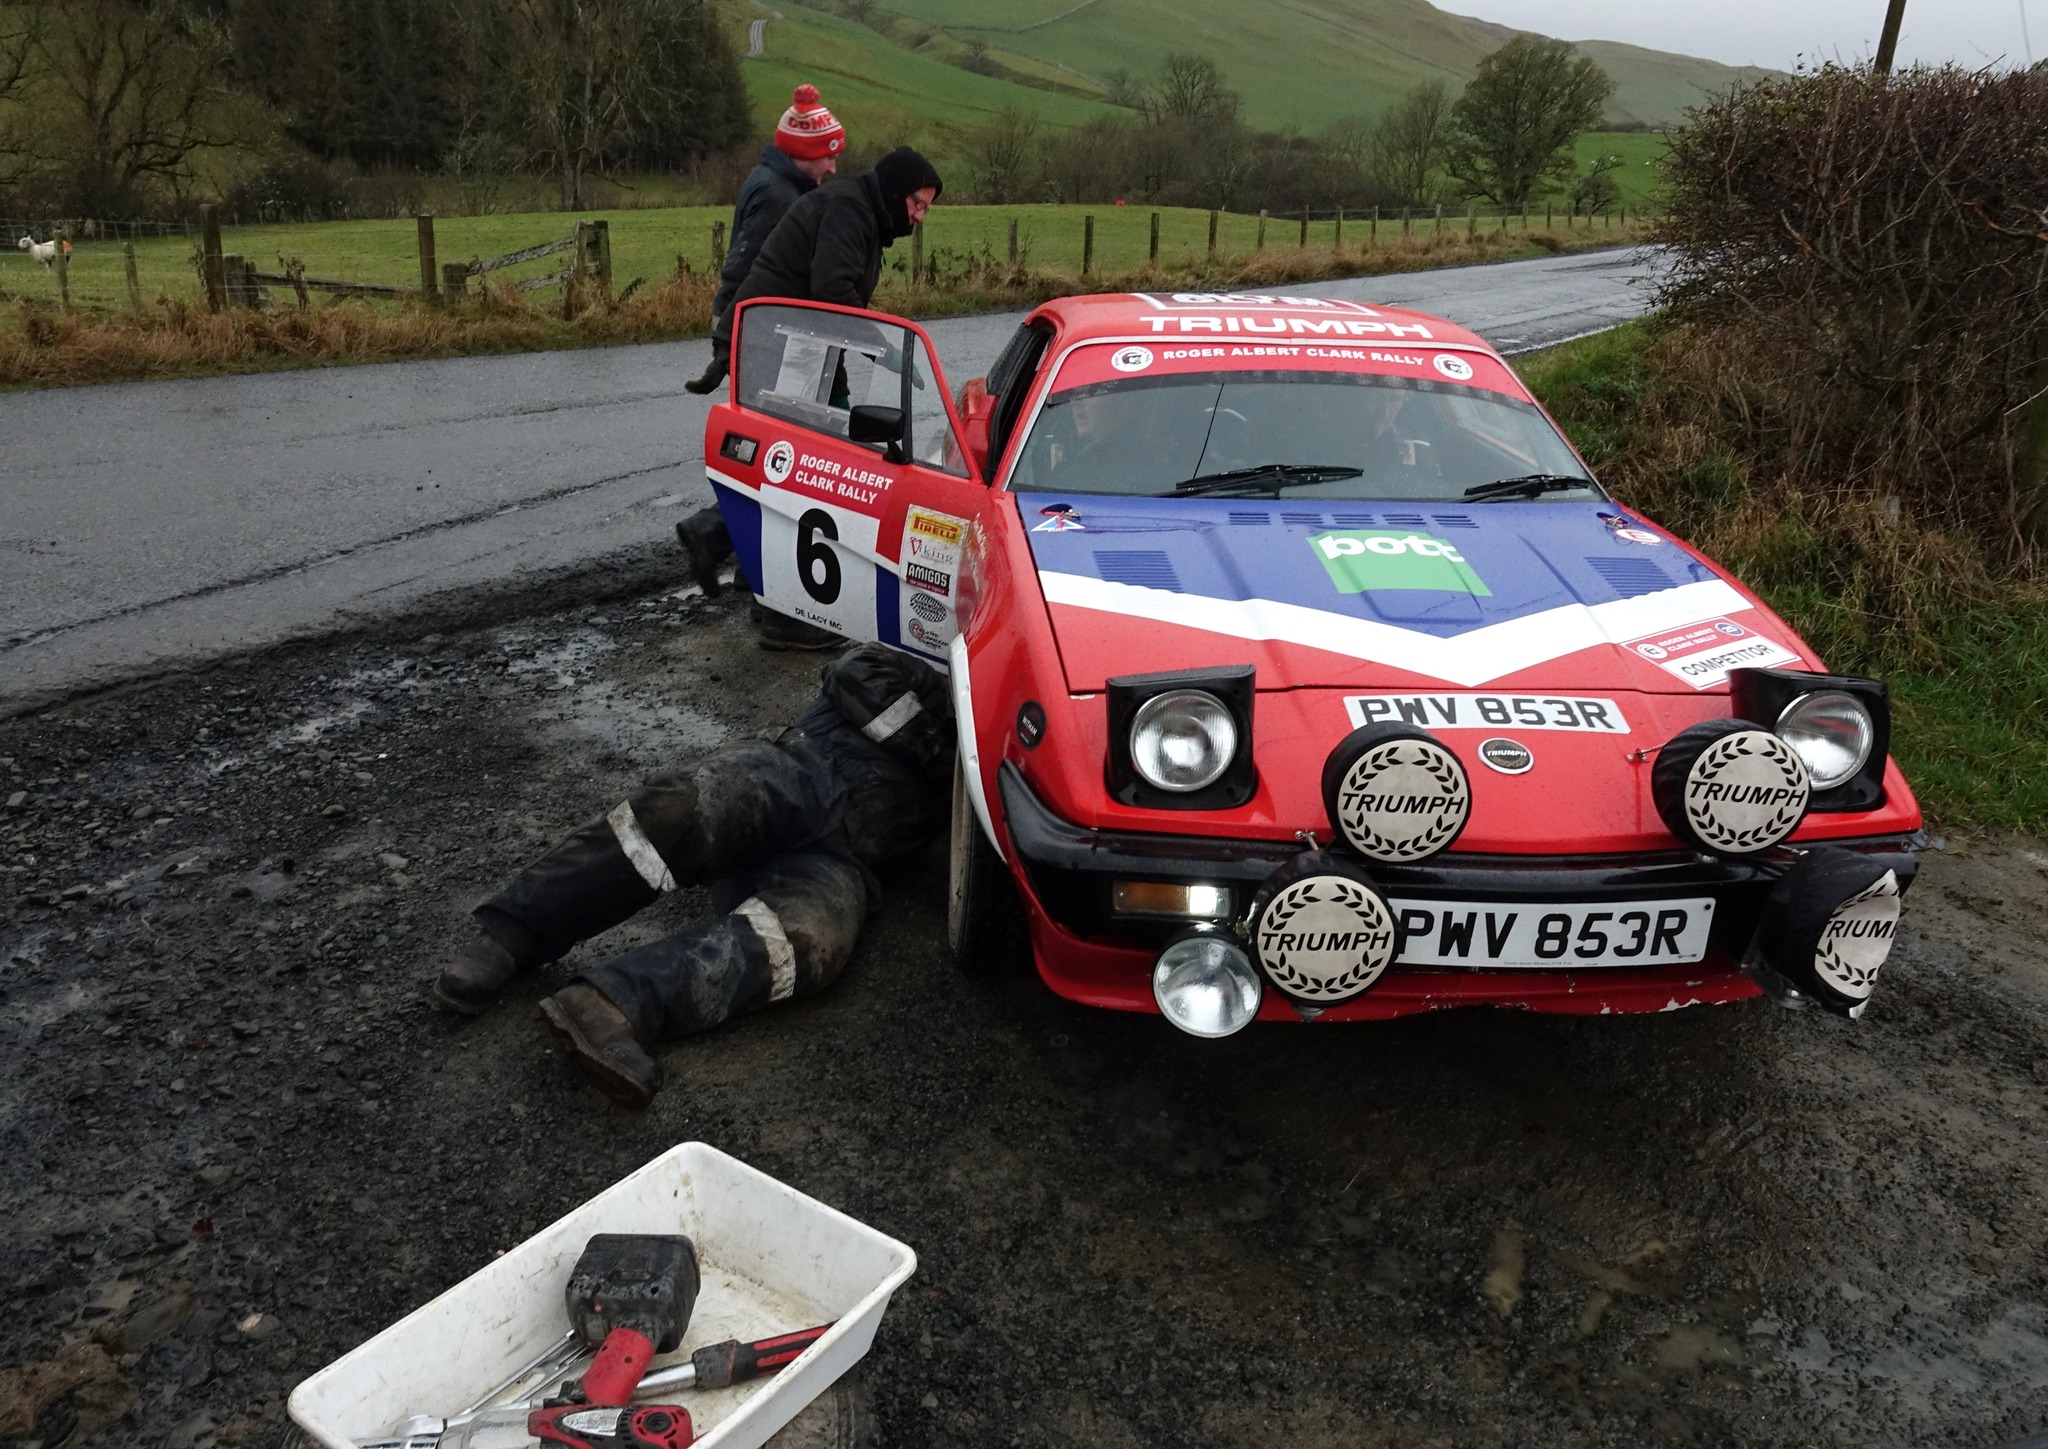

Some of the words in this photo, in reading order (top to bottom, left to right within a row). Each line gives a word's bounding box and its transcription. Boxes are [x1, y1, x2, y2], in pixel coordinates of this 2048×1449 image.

[1139, 316, 1434, 338] TRIUMPH
[1163, 349, 1226, 360] ROGER
[1231, 347, 1300, 358] ALBERT
[1306, 348, 1366, 360] CLARK
[1371, 352, 1424, 366] RALLY
[799, 454, 841, 476] ROGER
[842, 467, 893, 491] ALBERT
[795, 470, 836, 493] CLARK
[837, 483, 878, 505] RALLY
[913, 515, 958, 540] PIRELLI
[797, 508, 842, 605] 6
[910, 537, 953, 566] Viking
[908, 564, 948, 587] AMIGOS
[795, 607, 806, 617] DE
[807, 612, 828, 625] LACY
[829, 620, 842, 631] MC
[1681, 644, 1775, 676] COMPETITOR
[1358, 697, 1458, 725] PWV
[1475, 697, 1616, 729] 853R
[1486, 748, 1527, 758] TRIUMPH
[1342, 792, 1465, 814] TRIUMPH
[1689, 780, 1806, 807] TRIUMPH
[1261, 931, 1391, 951] TRIUMPH
[1400, 909, 1519, 958] PWV
[1534, 909, 1688, 958] 853R
[1827, 920, 1898, 939] RIUM
